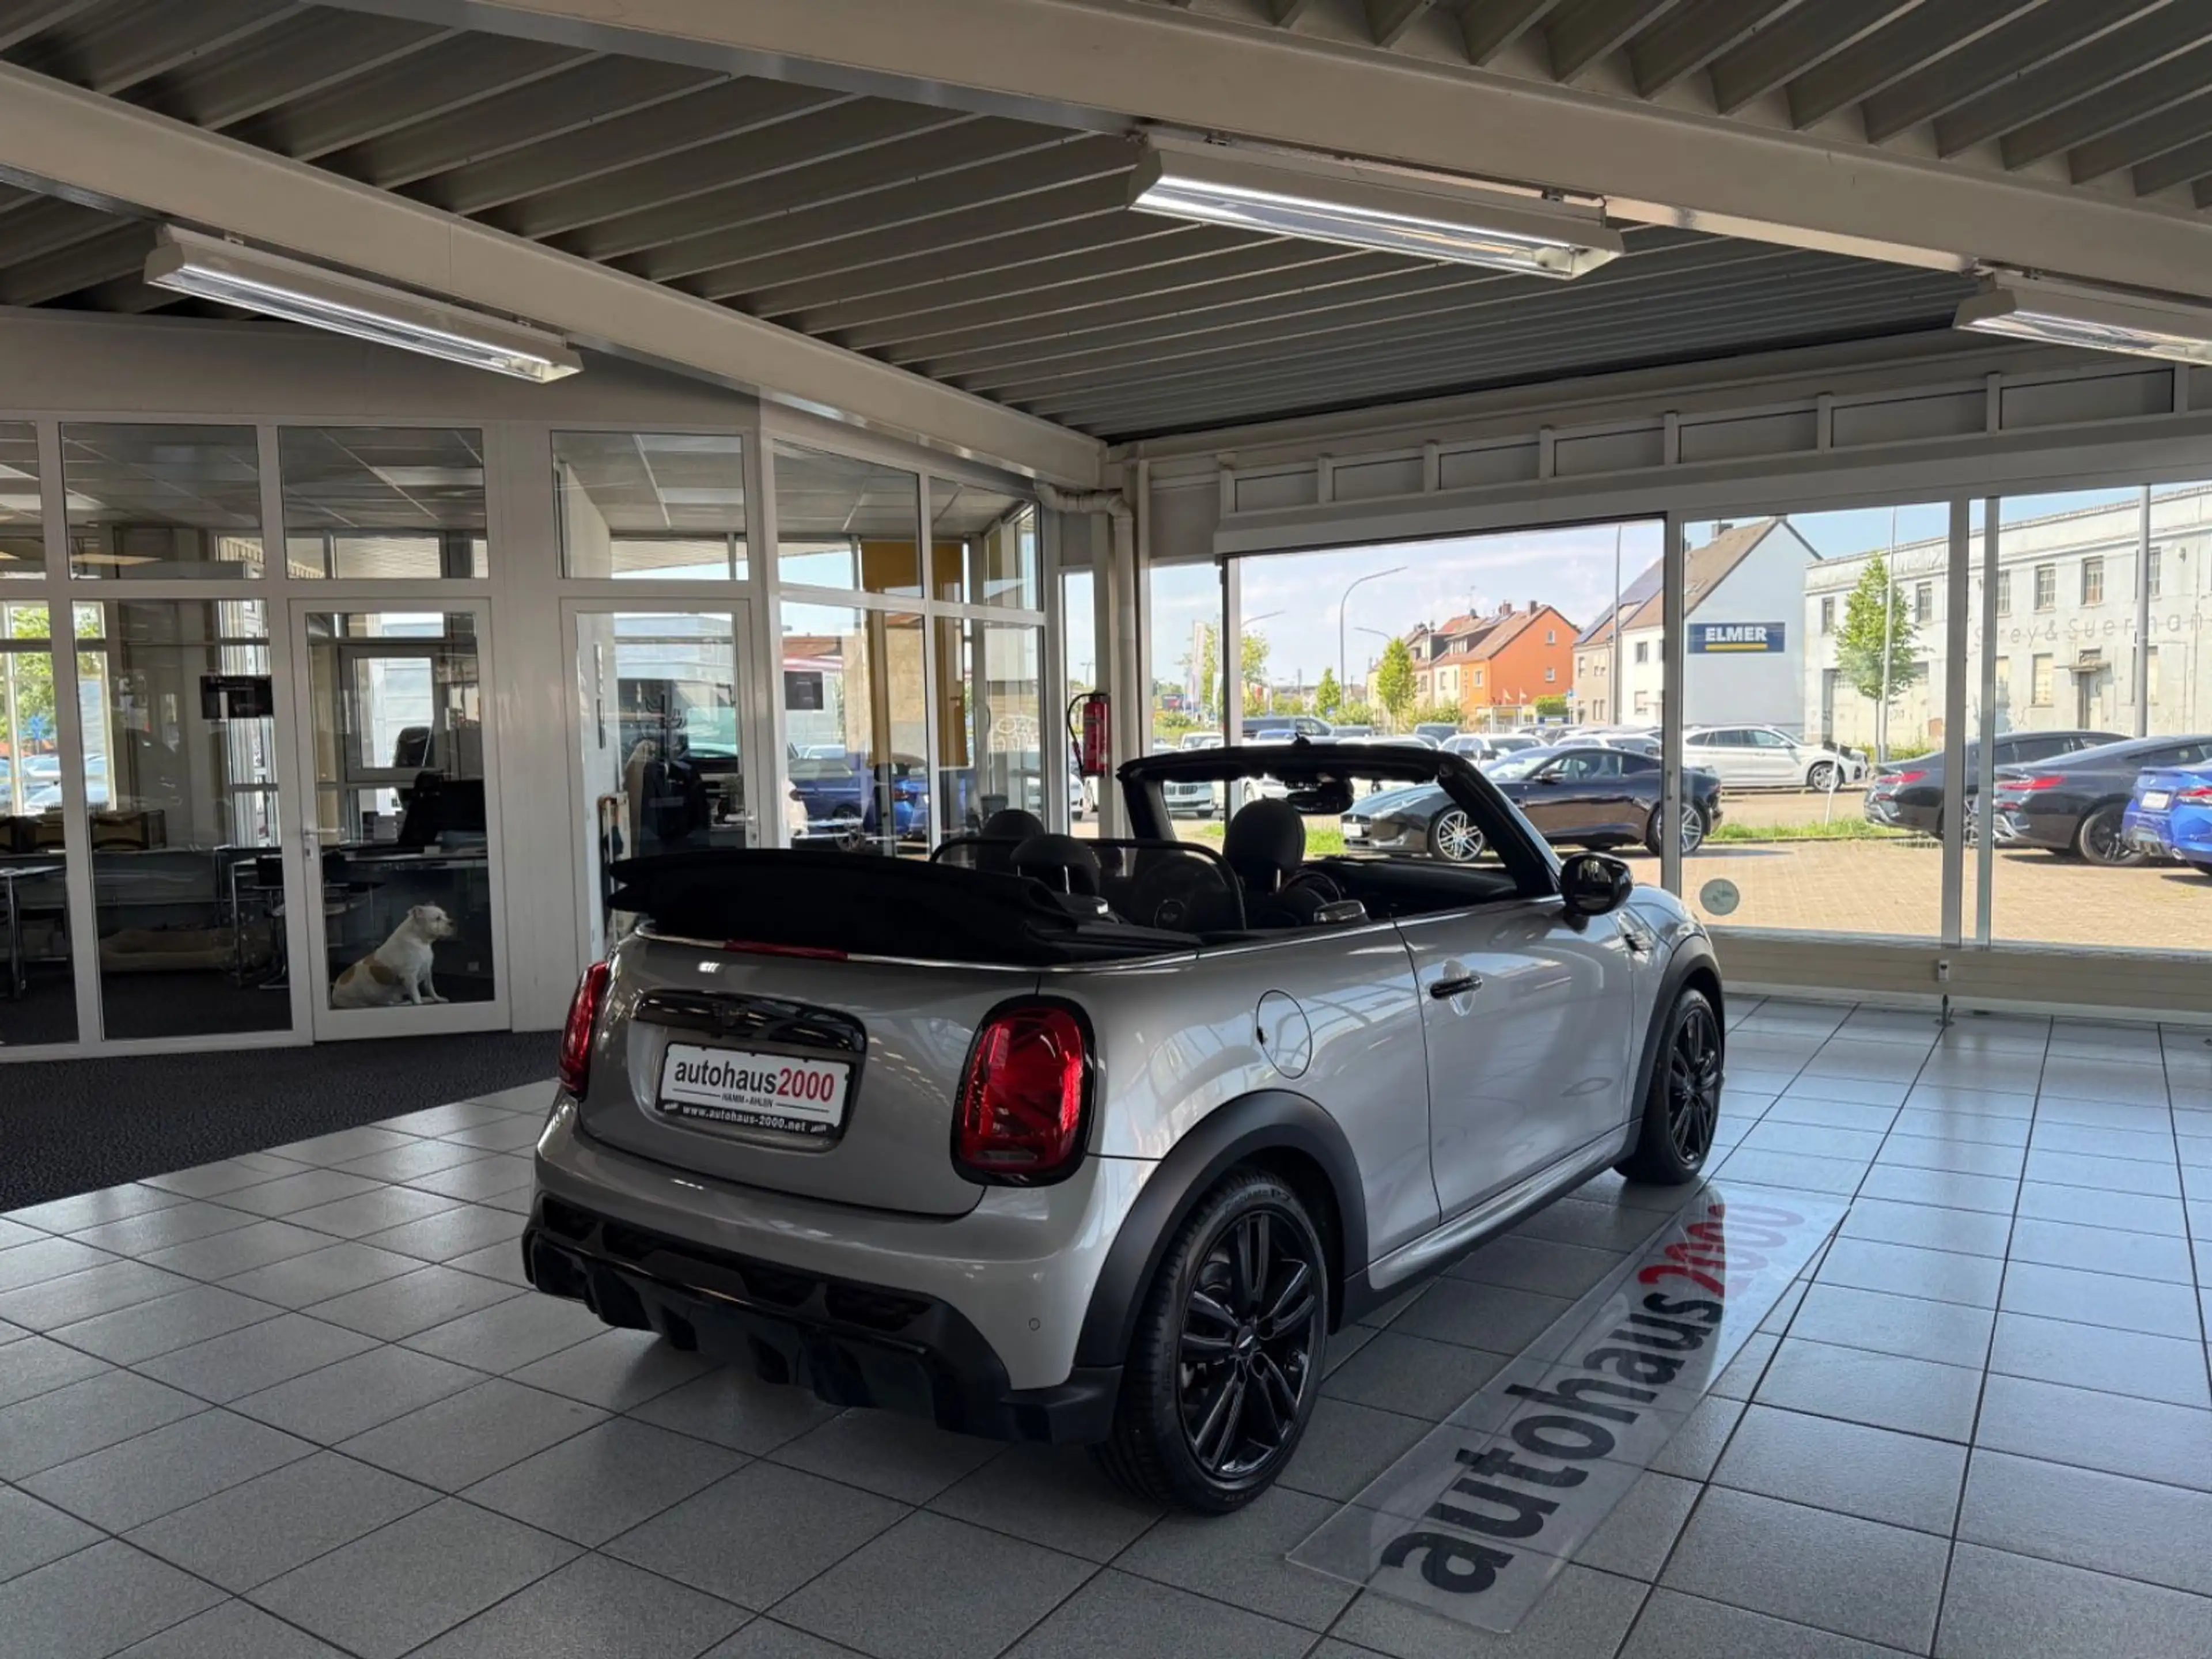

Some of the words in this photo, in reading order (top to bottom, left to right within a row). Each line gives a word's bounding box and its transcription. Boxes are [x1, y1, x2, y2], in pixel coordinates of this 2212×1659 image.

[1705, 626, 1768, 642] ELMER
[674, 1059, 835, 1103] autohaus2000
[682, 1105, 806, 1132] www.autohaus-2000.net
[1380, 1203, 1805, 1594] autohaus2000
